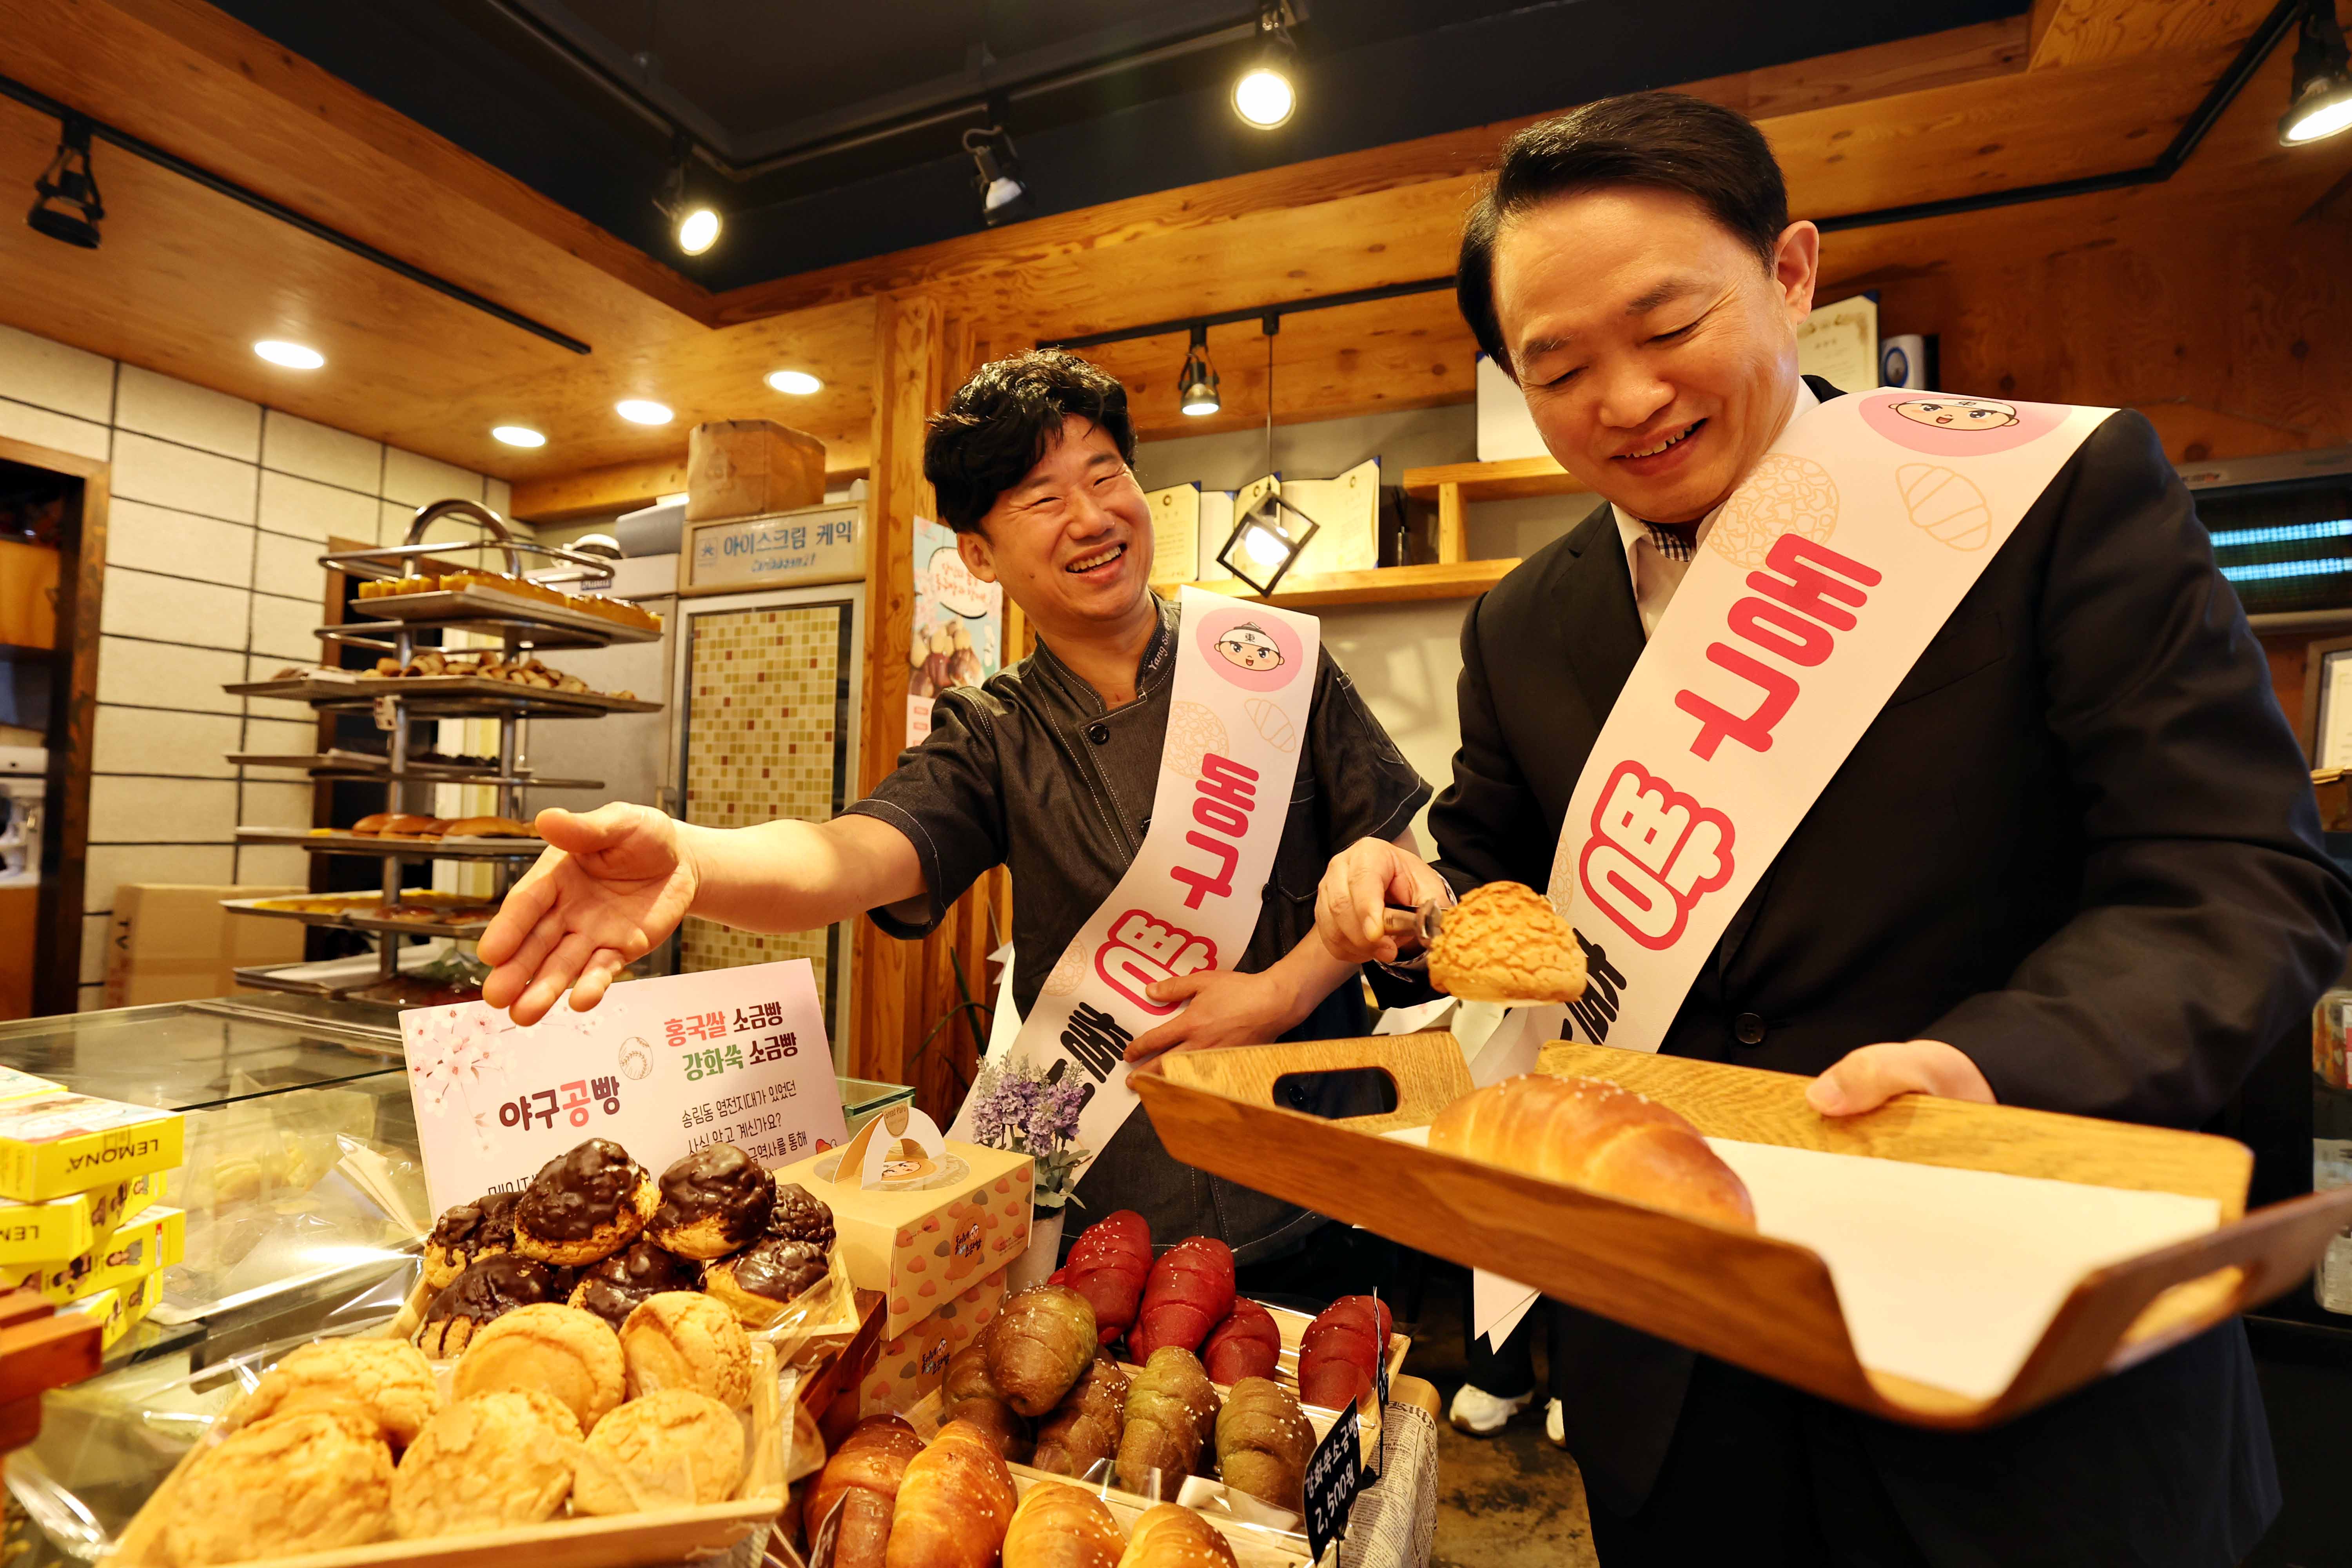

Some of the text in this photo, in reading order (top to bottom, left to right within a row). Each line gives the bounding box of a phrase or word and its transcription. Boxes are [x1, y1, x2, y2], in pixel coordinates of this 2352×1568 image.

[724, 521, 852, 557] 아이스크림 케익
[1148, 646, 1168, 670] Yang
[664, 1001, 783, 1047] 홍국쌀 소금빵
[682, 1032, 798, 1081] 강화쑥 소금빵
[499, 1076, 620, 1131] 야구공빵
[682, 1080, 797, 1128] 송림동 염전지대가 있었던
[736, 1112, 782, 1139] 계신가요?
[788, 1131, 808, 1152] 통해
[69, 1138, 158, 1168] LEMONA
[1315, 1458, 1355, 1535] 2,500원
